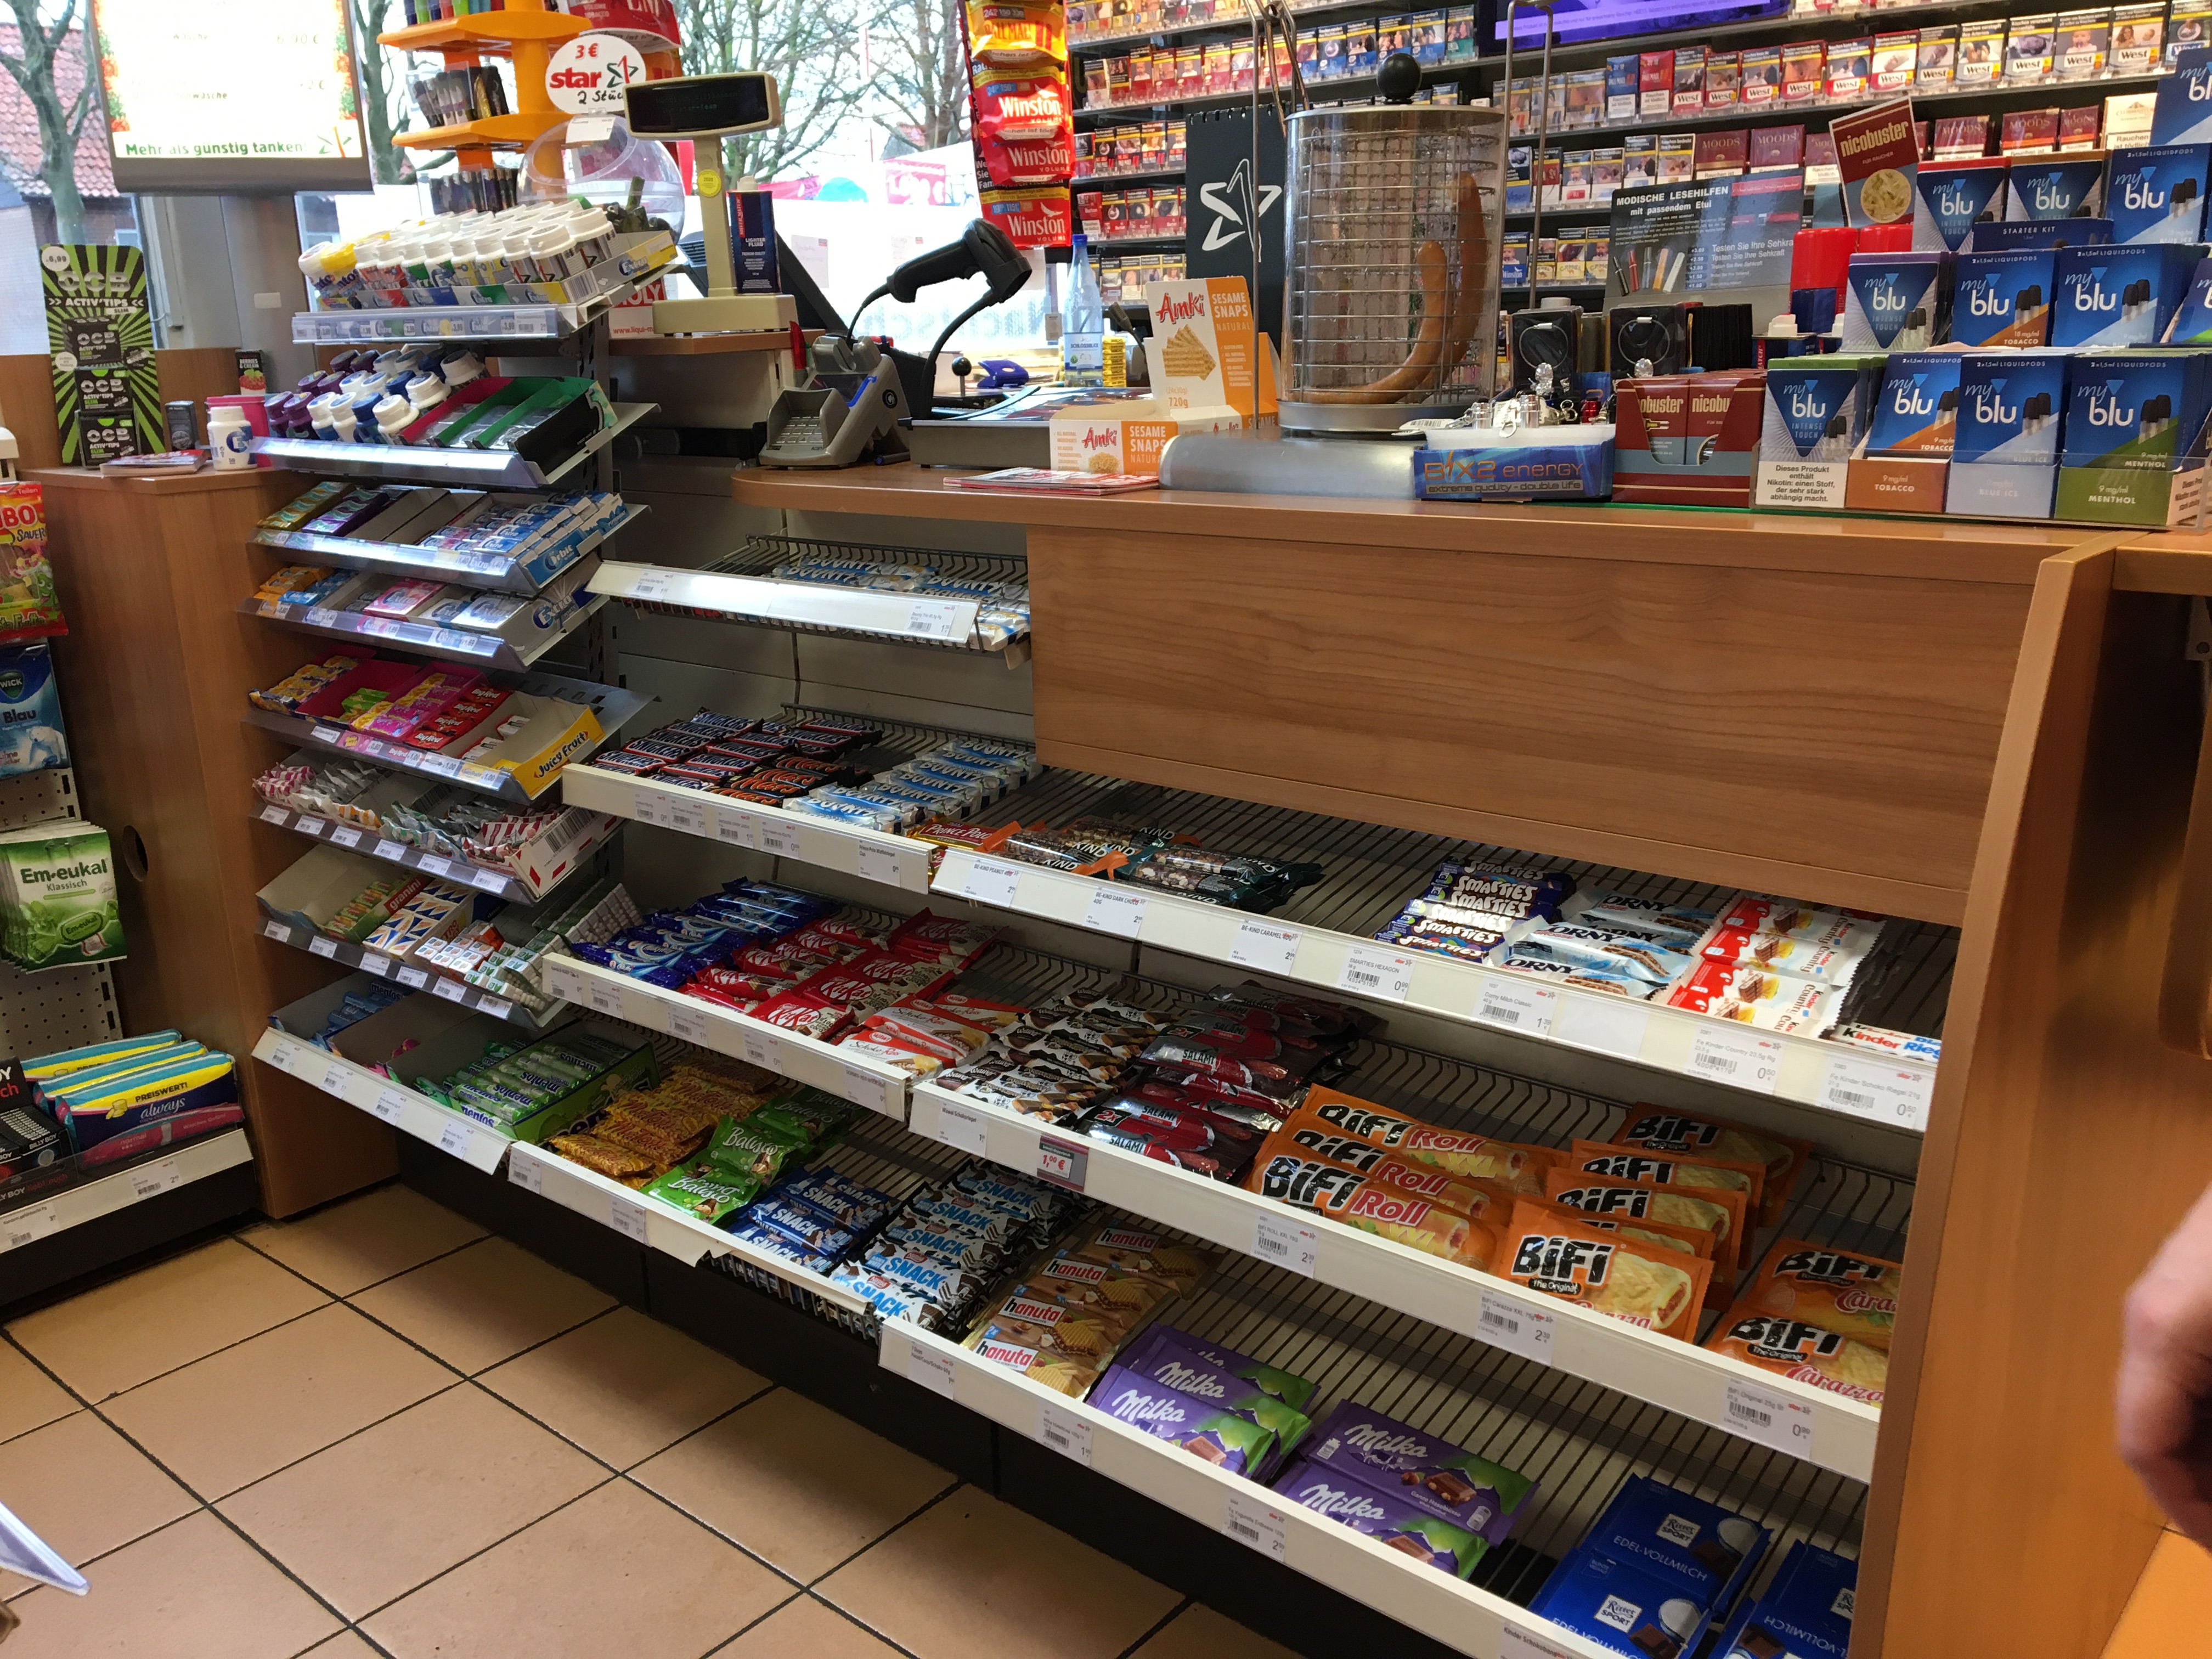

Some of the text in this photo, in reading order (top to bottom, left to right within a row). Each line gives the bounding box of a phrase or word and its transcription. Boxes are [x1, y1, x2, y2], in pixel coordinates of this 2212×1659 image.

[575, 43, 599, 59] 3 €
[549, 67, 601, 89] star
[1881, 73, 1906, 83] West
[1922, 69, 1946, 79] West
[1967, 64, 1991, 75] West
[1749, 87, 1771, 97] West
[1790, 83, 1812, 92] West
[1835, 79, 1858, 89] West
[577, 91, 624, 104] 2 Stüc
[1677, 94, 1699, 103] West
[1711, 92, 1732, 101] West
[998, 97, 1062, 117] Winston
[1702, 137, 1741, 149] MOODS
[1758, 132, 1797, 144] MOODS
[1840, 120, 1909, 157] nicobuster
[126, 143, 162, 156] Mehr
[170, 144, 189, 155] als
[194, 142, 248, 156] günstig
[1007, 146, 1069, 167] Winston
[1616, 186, 1729, 206] MODISCHE LESEHILFEN
[1941, 193, 1973, 216] blu
[2035, 189, 2070, 210] blu
[2125, 188, 2164, 210] blu
[1630, 200, 1712, 216] mit passendem Etui
[1007, 215, 1065, 236] Winston
[2002, 225, 2056, 235] STARTER KIT
[1711, 253, 1731, 261] Testen
[1733, 252, 1743, 260] Sie
[1758, 249, 1785, 258] Sehkraft
[1712, 239, 1794, 252] Testen Sie Ihre Sehkra
[2100, 248, 2146, 256] LIQUIDPODS
[1994, 255, 2038, 263] LIQUIDPODS
[58, 271, 131, 292] OCB
[65, 297, 128, 307] ACTIV'TIPS
[1211, 292, 1246, 304] SESAME
[1872, 287, 1906, 311] blu
[1971, 289, 2009, 317] blu
[2074, 283, 2116, 312] blu
[1155, 292, 1205, 324] Amki
[1214, 304, 1249, 318] SNAPS
[1216, 321, 1251, 331] NATURAL
[80, 379, 125, 393] OCB
[1784, 385, 1805, 400] my
[1169, 397, 1189, 408] 720g
[1792, 394, 1826, 417] blu
[1894, 389, 1933, 415] blu
[87, 428, 130, 443] OCB
[1081, 427, 1118, 450] Amki
[1129, 425, 1166, 438] SESAME
[1130, 438, 1166, 453] SNAPS
[1562, 481, 1581, 489] life
[2088, 495, 2136, 504] MENTHOL
[4, 709, 37, 724] Blau
[538, 730, 587, 777] Juicy Fruit
[926, 823, 964, 836] PRINCE
[1071, 841, 1107, 858] KIND
[20, 859, 108, 884] Em-eukal
[1042, 857, 1079, 871] KIND
[46, 879, 88, 891] Klassisch
[388, 878, 422, 910] granini
[1453, 875, 1538, 901] SMARTIES
[1451, 890, 1533, 917] SMARTIES
[1430, 904, 1513, 933] SMARTIES
[1260, 929, 1282, 939] CARAMEL
[1413, 919, 1498, 944] SMARTIES
[1350, 958, 1400, 974] SMARTIES HEXAGON
[821, 979, 874, 1001] KitKat
[1500, 995, 1513, 1003] Milch
[1514, 997, 1532, 1008] Classic
[767, 1007, 822, 1029] KitKat
[1212, 1021, 1248, 1036] SALAMI
[1182, 1048, 1215, 1065] SALAMI
[1705, 1041, 1724, 1051] Kinder
[1725, 1046, 1748, 1057] Country
[1903, 1041, 1942, 1058] Rieg
[1839, 1075, 1859, 1085] Kinder
[135, 1082, 188, 1102] PREISWERT!
[140, 1098, 186, 1119] always
[1141, 1105, 1178, 1122] SALAMI
[1108, 1135, 1146, 1155] SALAMI
[1407, 1128, 1487, 1153] Roll
[1445, 1152, 1497, 1178] XXL
[1374, 1161, 1453, 1196] Roll
[803, 1186, 853, 1214] SNACK
[976, 1181, 1038, 1207] SNACK
[1260, 1154, 1432, 1227] BiFi Roll
[933, 1202, 992, 1231] SNACK
[906, 1225, 967, 1257] SNACK
[1102, 1229, 1154, 1249] hanuta
[1510, 1234, 1616, 1287] BiFi
[884, 1258, 949, 1290] SNACK
[1047, 1260, 1103, 1282] hanuta
[1533, 1280, 1548, 1290] The
[1006, 1300, 1063, 1323] hanuta
[977, 1340, 1034, 1368] hanuta
[1155, 1361, 1225, 1399] Milka
[1111, 1389, 1187, 1424] Milka
[1343, 1424, 1429, 1458] Milka
[1299, 1483, 1386, 1522] Milka
[1661, 1526, 1691, 1543] SPORT
[1613, 1535, 1708, 1583] EDEL-VOLLMILCH
[1600, 1606, 1632, 1627] SPORT
